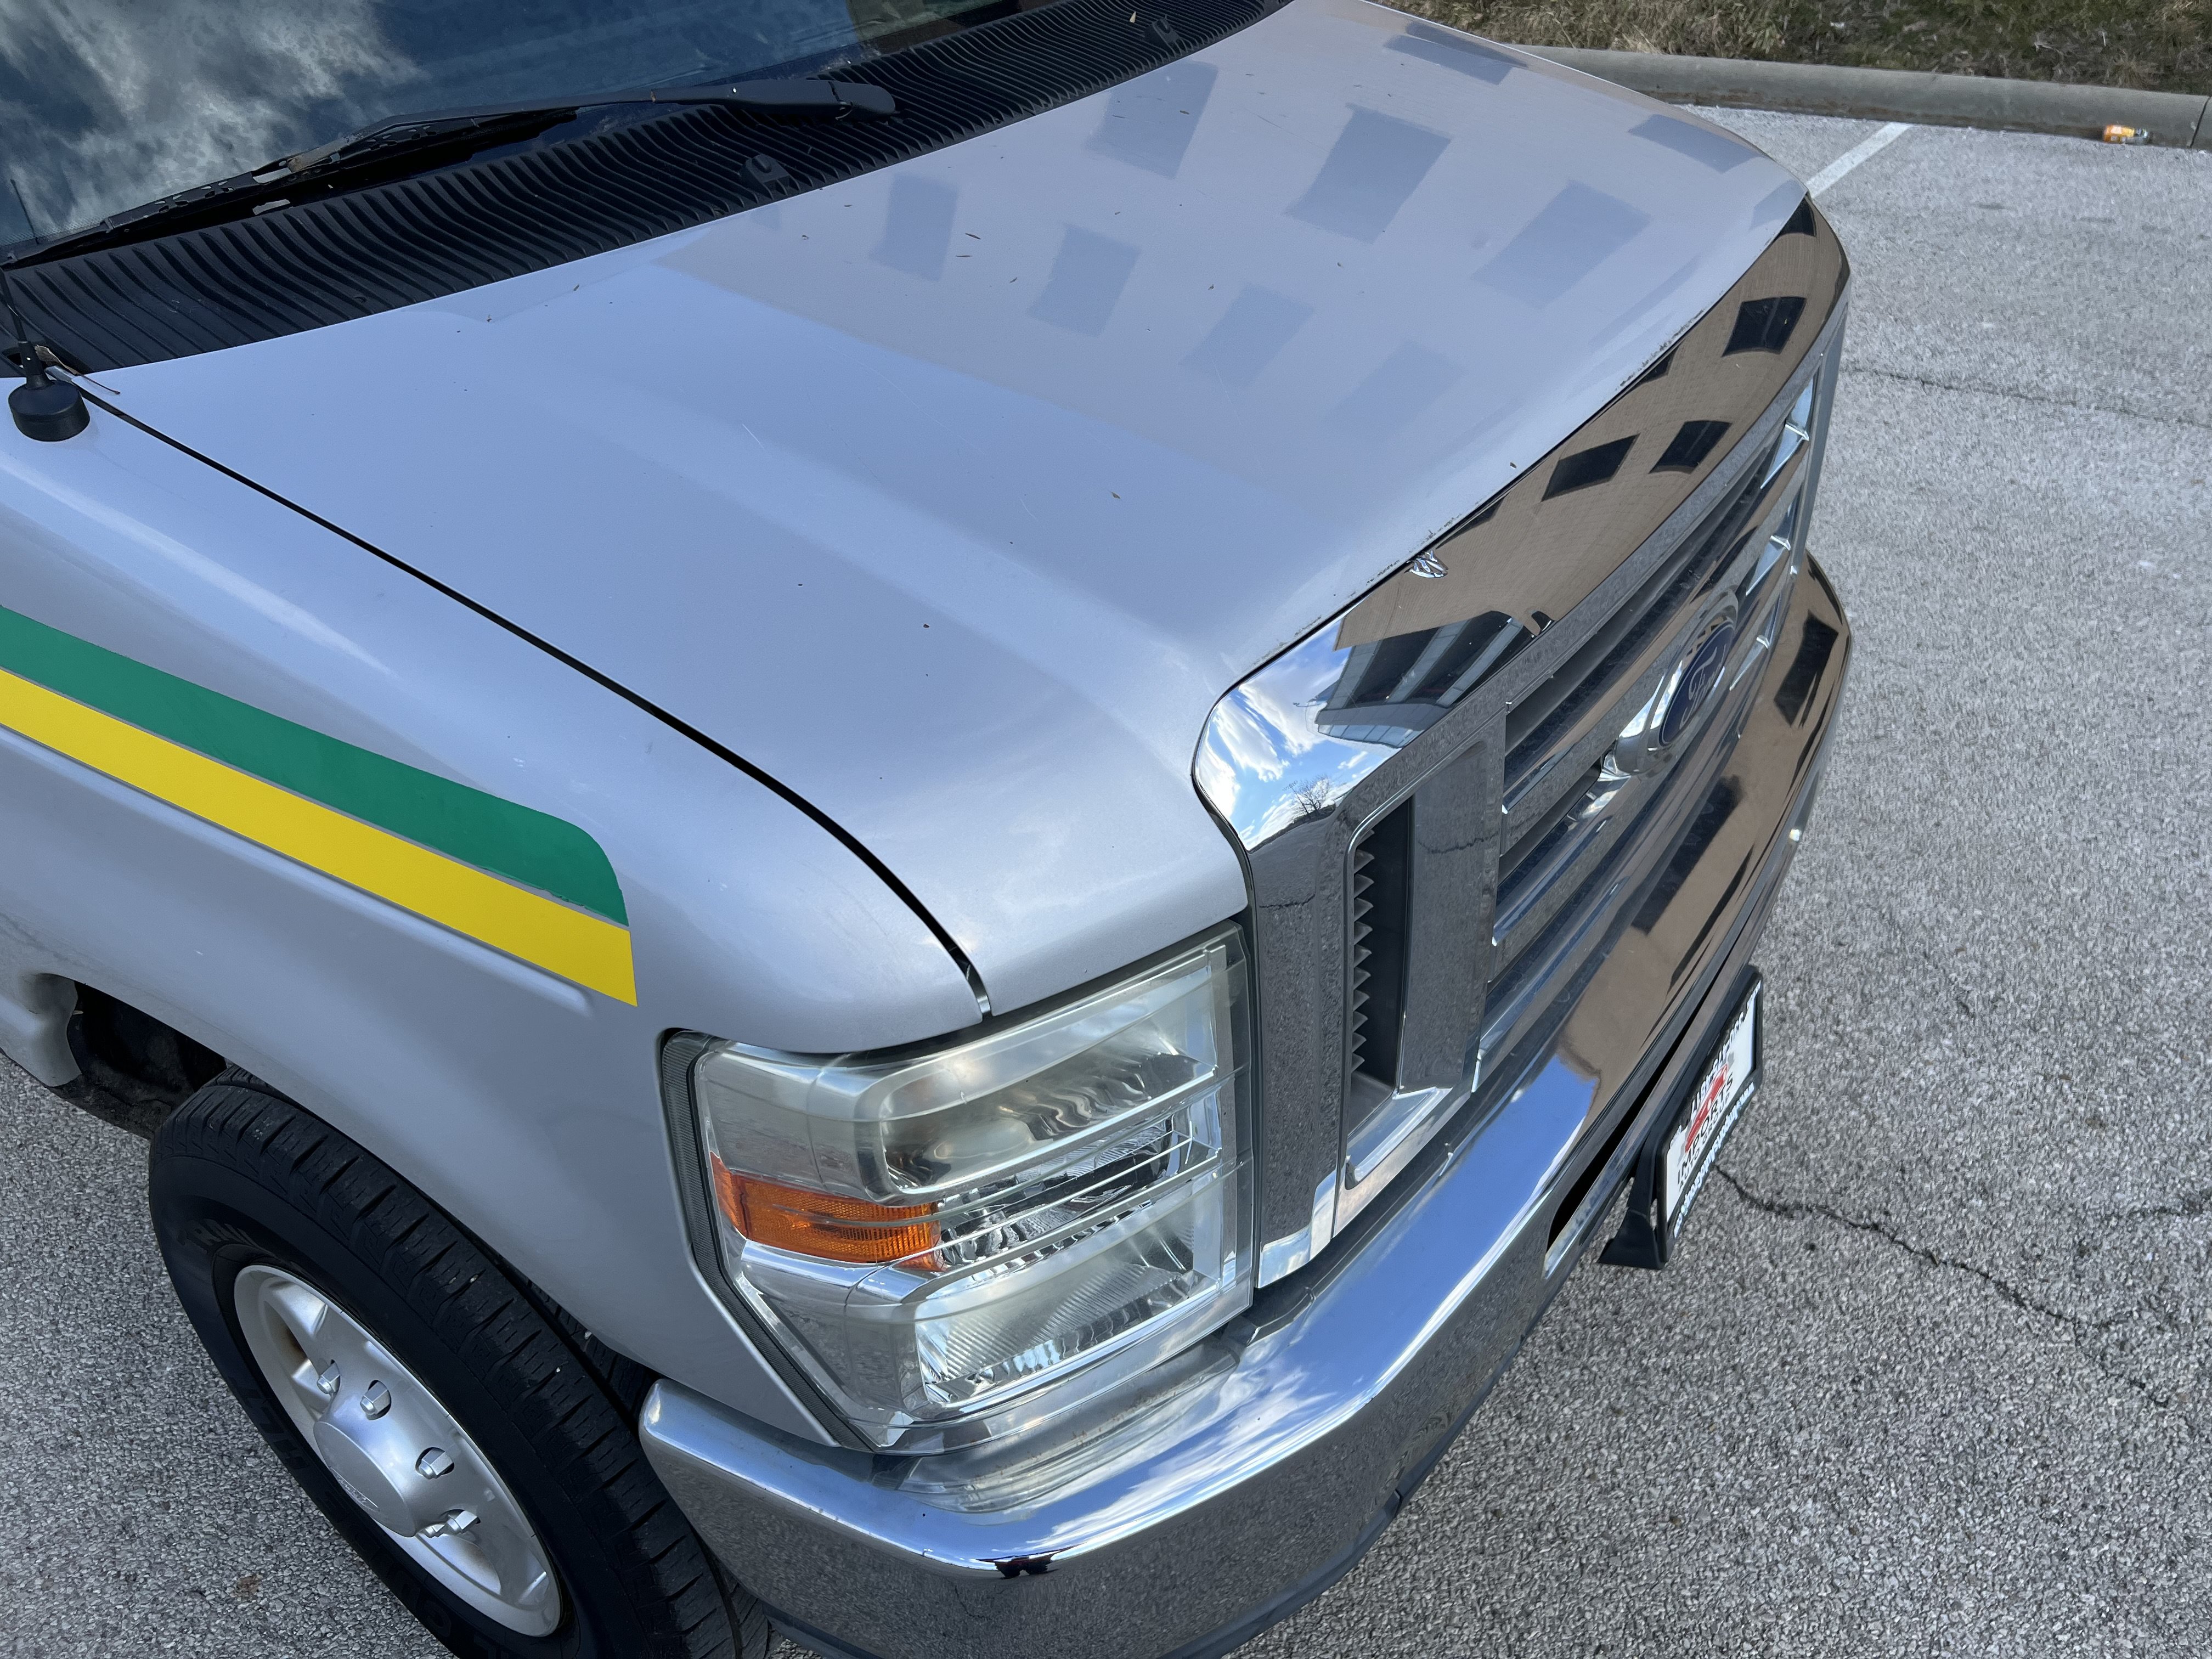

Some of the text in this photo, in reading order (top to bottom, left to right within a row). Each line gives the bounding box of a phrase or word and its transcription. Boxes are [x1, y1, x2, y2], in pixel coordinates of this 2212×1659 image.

[1678, 1071, 1733, 1185] IMPORTS
[1679, 1092, 1730, 1194] AUTO GROUP
